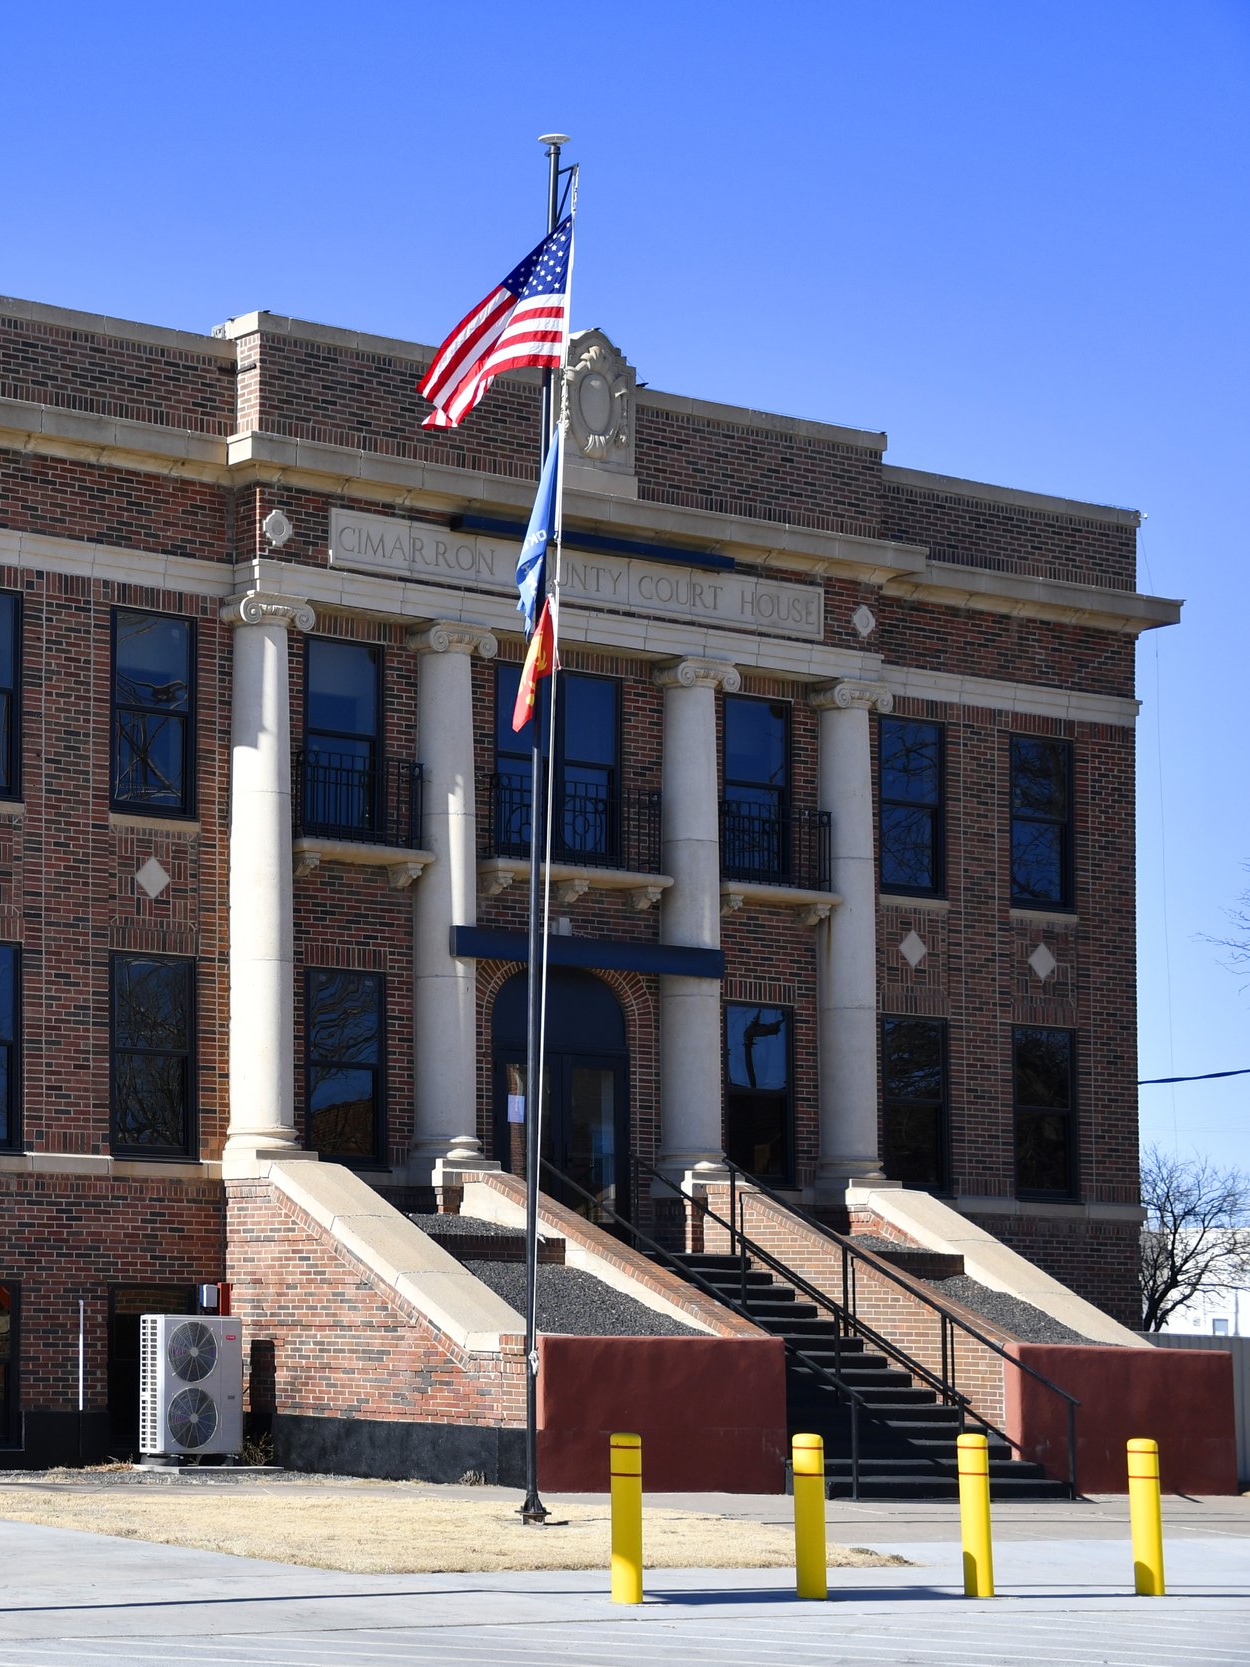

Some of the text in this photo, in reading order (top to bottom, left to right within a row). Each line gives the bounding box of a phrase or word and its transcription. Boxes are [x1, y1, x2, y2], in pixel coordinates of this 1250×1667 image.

[338, 526, 495, 576] CIMARRON
[638, 575, 723, 610] COURT
[740, 590, 815, 625] HOUSE
